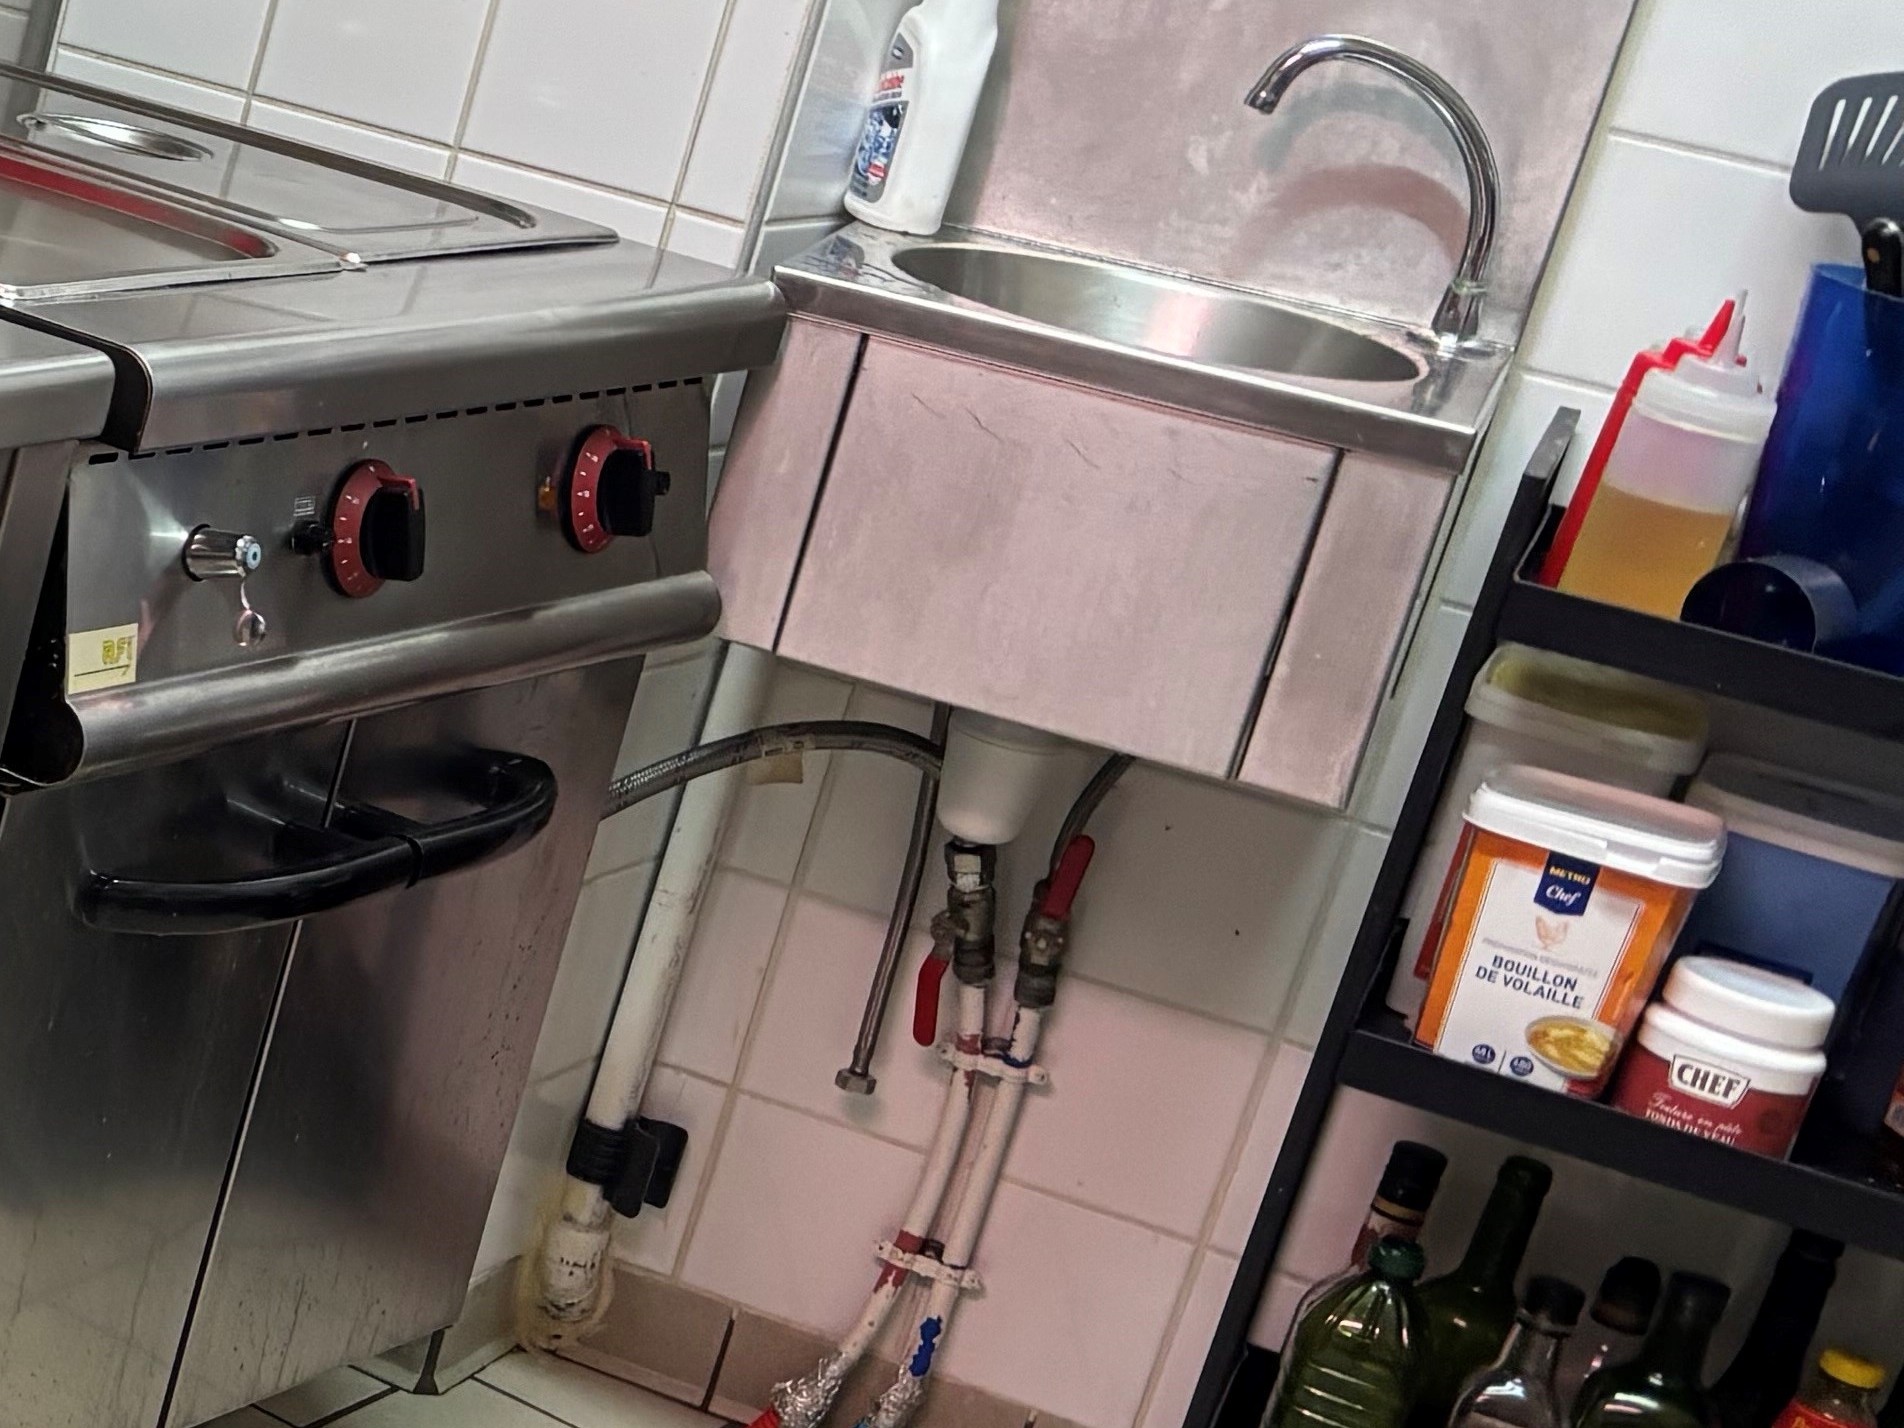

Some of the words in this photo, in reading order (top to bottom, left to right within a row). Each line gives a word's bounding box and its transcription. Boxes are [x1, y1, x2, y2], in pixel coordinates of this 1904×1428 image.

[1549, 866, 1591, 885] METRO
[1546, 884, 1581, 907] Chef
[1475, 966, 1498, 984] DE
[1503, 973, 1585, 1009] VOLAILLE
[1492, 955, 1578, 992] BOUILLON
[1677, 1063, 1741, 1099] CHEF
